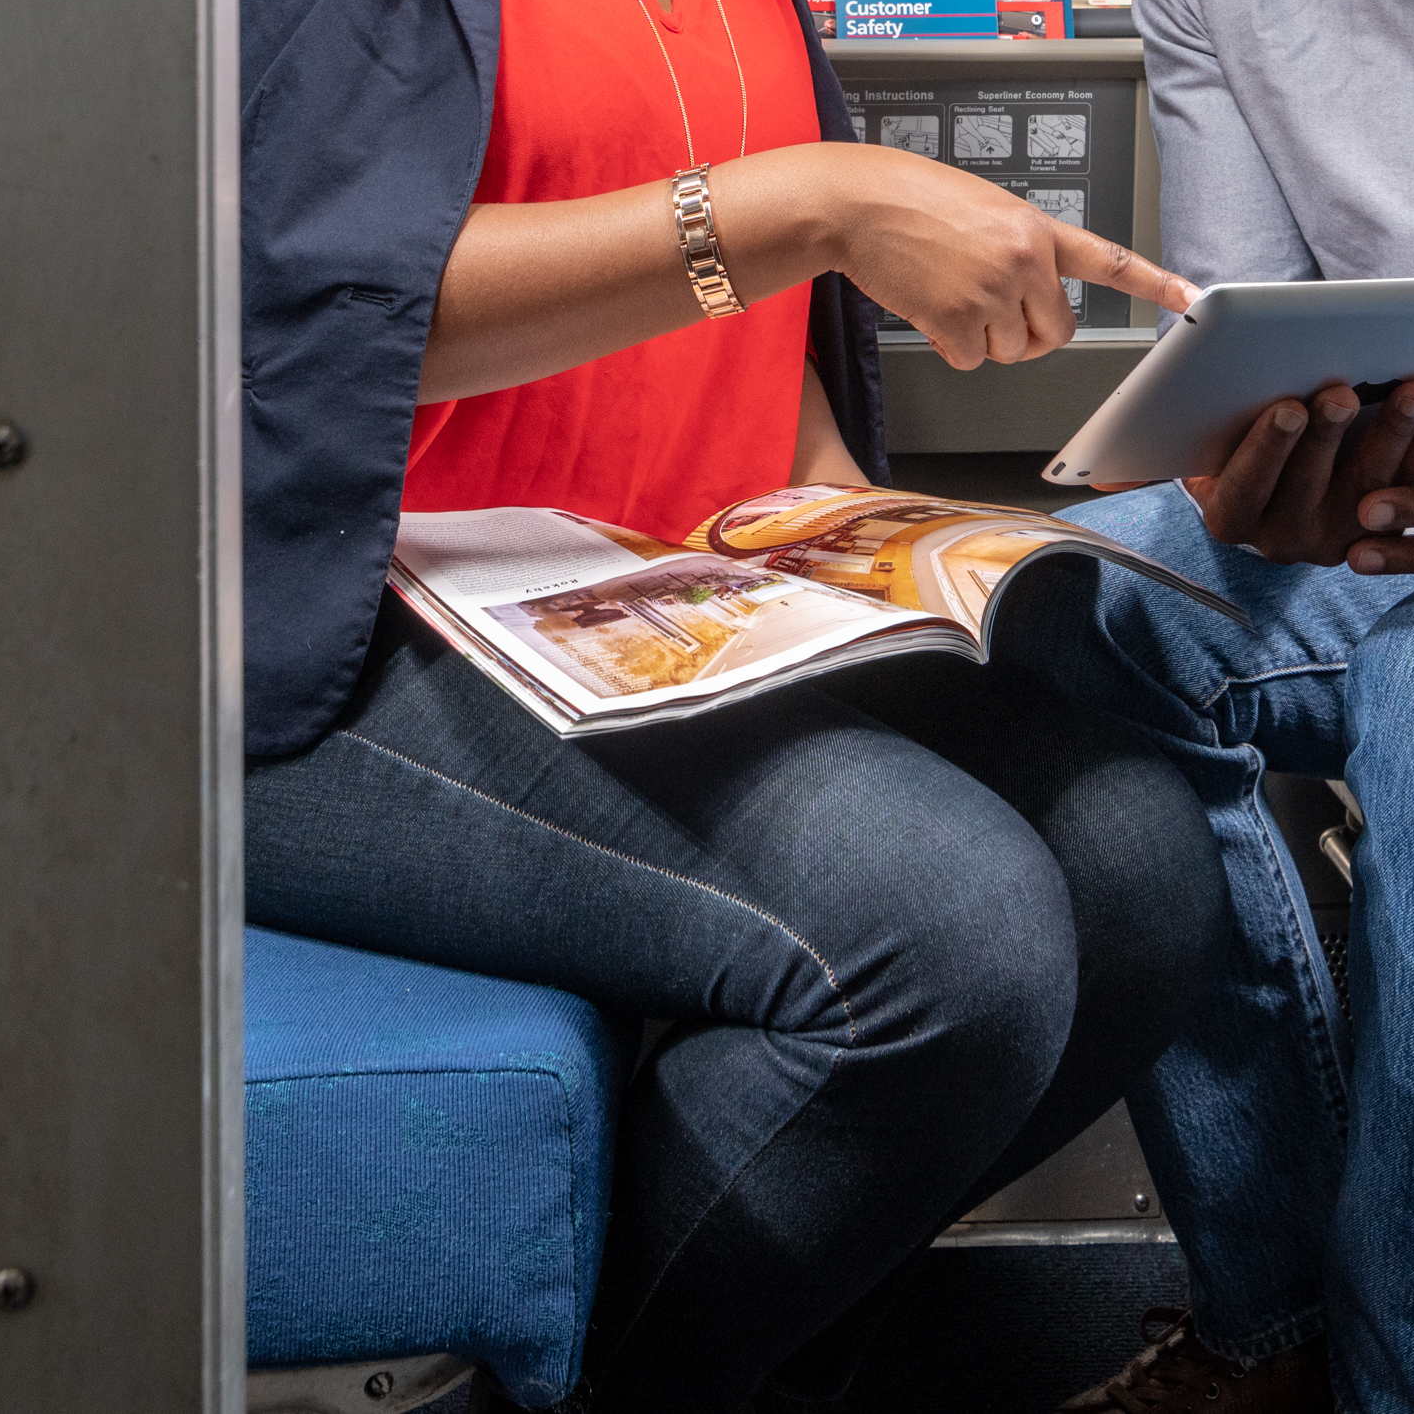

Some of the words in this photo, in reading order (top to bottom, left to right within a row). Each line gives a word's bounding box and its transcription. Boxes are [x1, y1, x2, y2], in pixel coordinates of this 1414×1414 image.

[845, 0, 932, 16] Customer
[846, 19, 903, 38] Safety
[865, 90, 934, 101] Instructions
[977, 91, 1022, 101] Superliner
[1026, 91, 1065, 101] Economy
[1068, 90, 1093, 99] Room
[954, 106, 985, 114] Reclining
[526, 579, 579, 594] Rokeby
